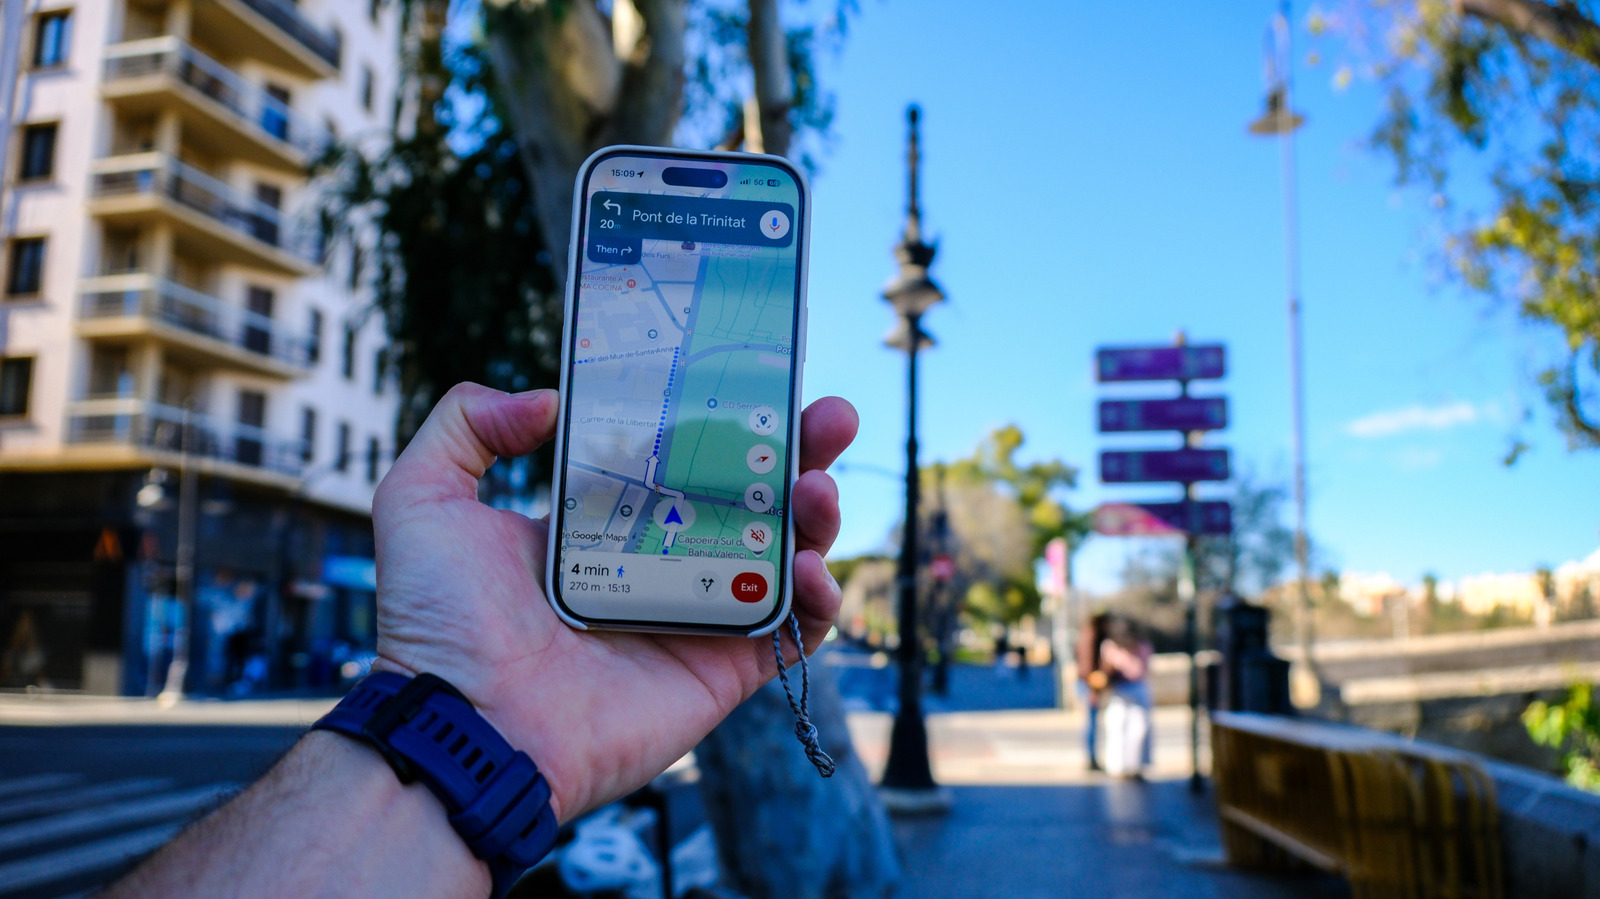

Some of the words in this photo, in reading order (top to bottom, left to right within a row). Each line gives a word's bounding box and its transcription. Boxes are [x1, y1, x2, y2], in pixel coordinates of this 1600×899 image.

[611, 169, 635, 178] 15:09
[632, 209, 662, 223] Pont
[665, 212, 683, 224] de
[686, 213, 698, 225] la
[700, 214, 746, 228] Trinitat
[596, 244, 618, 254] Then
[722, 401, 735, 409] CD
[606, 416, 616, 424] de
[626, 419, 657, 428] Llibertat
[572, 530, 602, 542] Google
[606, 534, 628, 542] Maps
[678, 535, 718, 546] Capoeira
[688, 548, 713, 557] Bahia
[572, 564, 580, 574] 4
[584, 564, 609, 576] min
[570, 582, 588, 591] 270
[608, 584, 630, 593] 15:13
[741, 583, 758, 592] Exit
